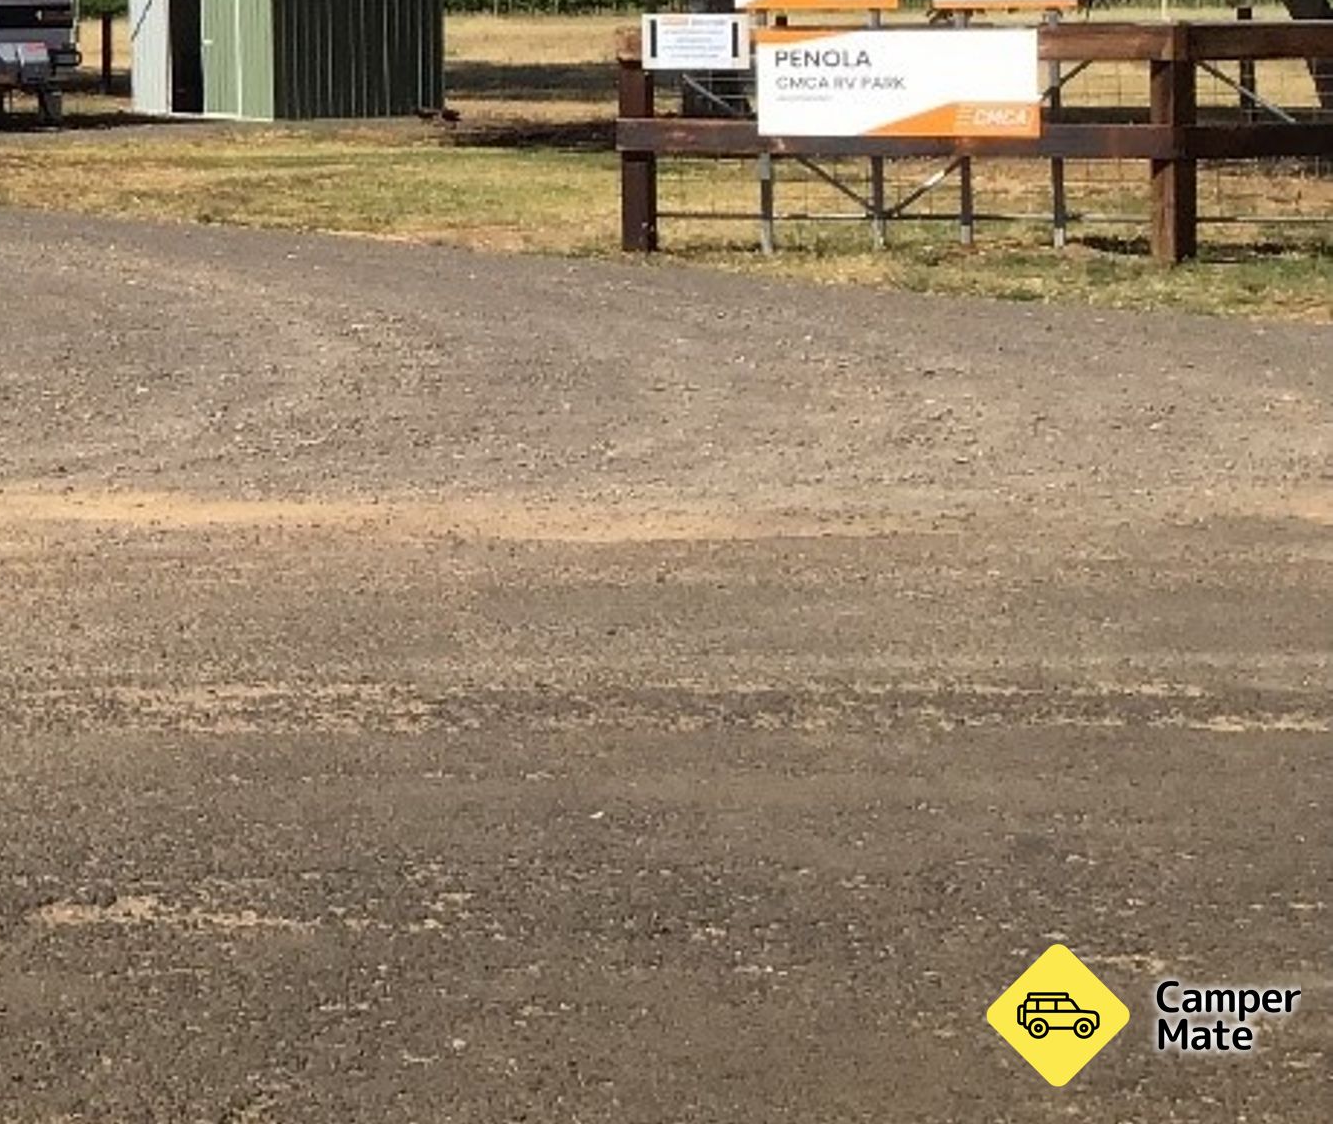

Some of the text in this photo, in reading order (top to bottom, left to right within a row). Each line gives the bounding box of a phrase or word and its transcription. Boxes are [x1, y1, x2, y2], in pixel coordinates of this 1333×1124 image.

[775, 49, 872, 67] PENOLA
[775, 76, 907, 90] CMCA RV PARK
[973, 107, 1028, 125] CMCA
